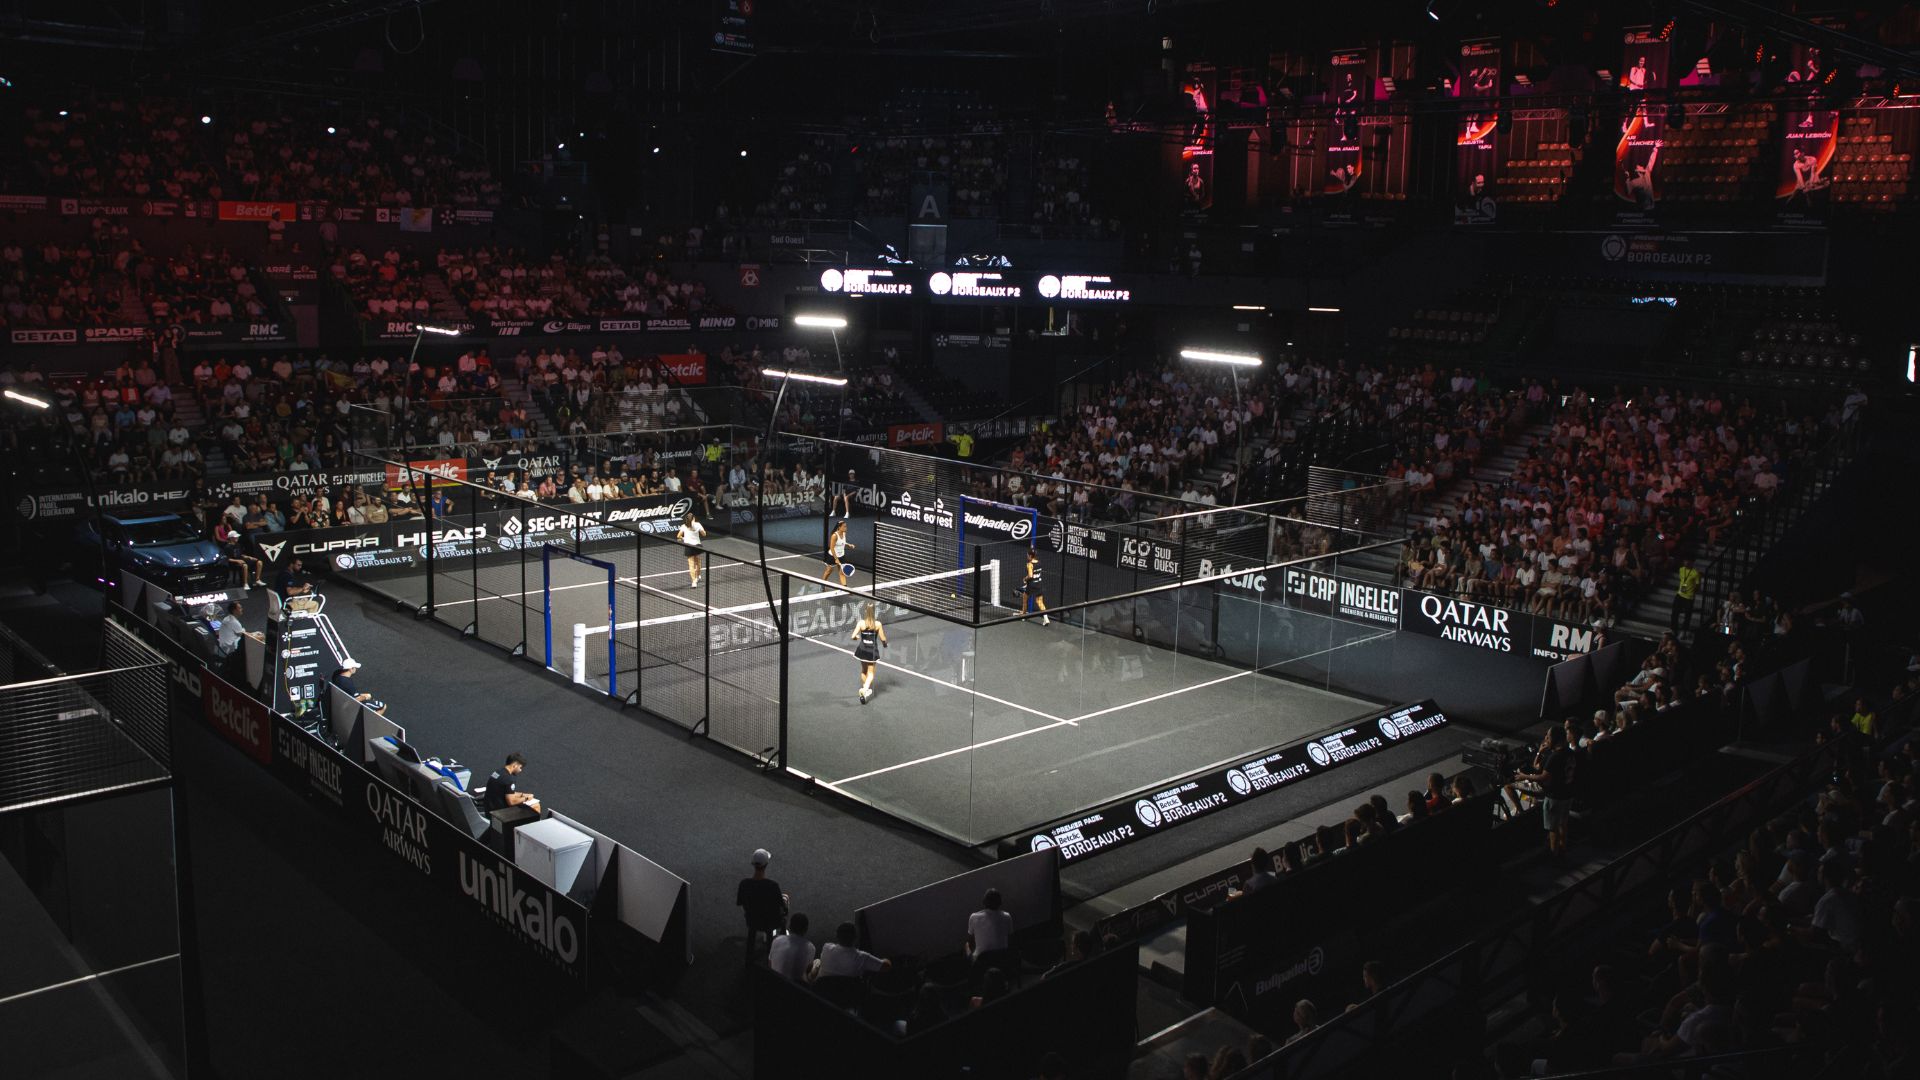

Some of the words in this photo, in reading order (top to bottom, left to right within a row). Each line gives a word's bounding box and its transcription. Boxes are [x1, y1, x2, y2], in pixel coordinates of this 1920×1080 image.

[918, 195, 941, 218] A
[1627, 252, 1694, 264] BORDEAUX
[1695, 253, 1713, 265] P2
[250, 323, 279, 335] RMC
[387, 322, 414, 333] RMC
[896, 427, 934, 441] Betclic
[518, 456, 560, 471] QATAR
[276, 473, 328, 491] QATAR
[39, 493, 83, 502] INTERNATIONAL
[39, 507, 76, 517] FEDERATION
[607, 503, 673, 523] Bullpadel
[890, 506, 921, 521] eovest
[293, 536, 380, 555] CUPRA
[481, 546, 493, 554] P2
[1067, 534, 1084, 547] PADEL
[356, 556, 402, 568] BORDEAUX
[1066, 545, 1098, 560] FEDERATON
[1155, 547, 1172, 561] SUD
[1154, 559, 1180, 576] OUEST
[1309, 575, 1336, 602] CAP
[1340, 581, 1399, 615] INGELEC
[1421, 595, 1510, 634] QATAR
[1440, 625, 1511, 653] AIRWAYS
[1550, 624, 1593, 654] RM
[1534, 648, 1558, 660] INFO
[211, 686, 260, 746] Betclic
[1400, 716, 1438, 737] BORDEAUX
[1434, 713, 1447, 724] P2
[1330, 740, 1372, 762] BORDEAUX
[1369, 736, 1383, 748] P2
[291, 736, 308, 769] CAP
[309, 746, 343, 795] INGELEC
[1252, 766, 1298, 791] BORDEAUX
[1295, 762, 1311, 775] P2
[1157, 788, 1181, 799] PREMIER
[1180, 782, 1199, 793] PADEL
[1160, 797, 1180, 809] Betclic
[1162, 796, 1215, 823] BORDEAUX
[1211, 791, 1229, 805] P2
[366, 781, 429, 849] QATAR
[1056, 821, 1084, 835] PREMIER
[1083, 814, 1104, 825] PADEL
[1058, 832, 1081, 845] Betclic
[1061, 829, 1121, 860] BORDEAUX
[1117, 824, 1135, 839] P2
[382, 827, 432, 876] AIRWAYS
[1183, 874, 1240, 904] CUPRA
[458, 850, 579, 965] unikalo
[1255, 959, 1309, 997] Bullpadel
